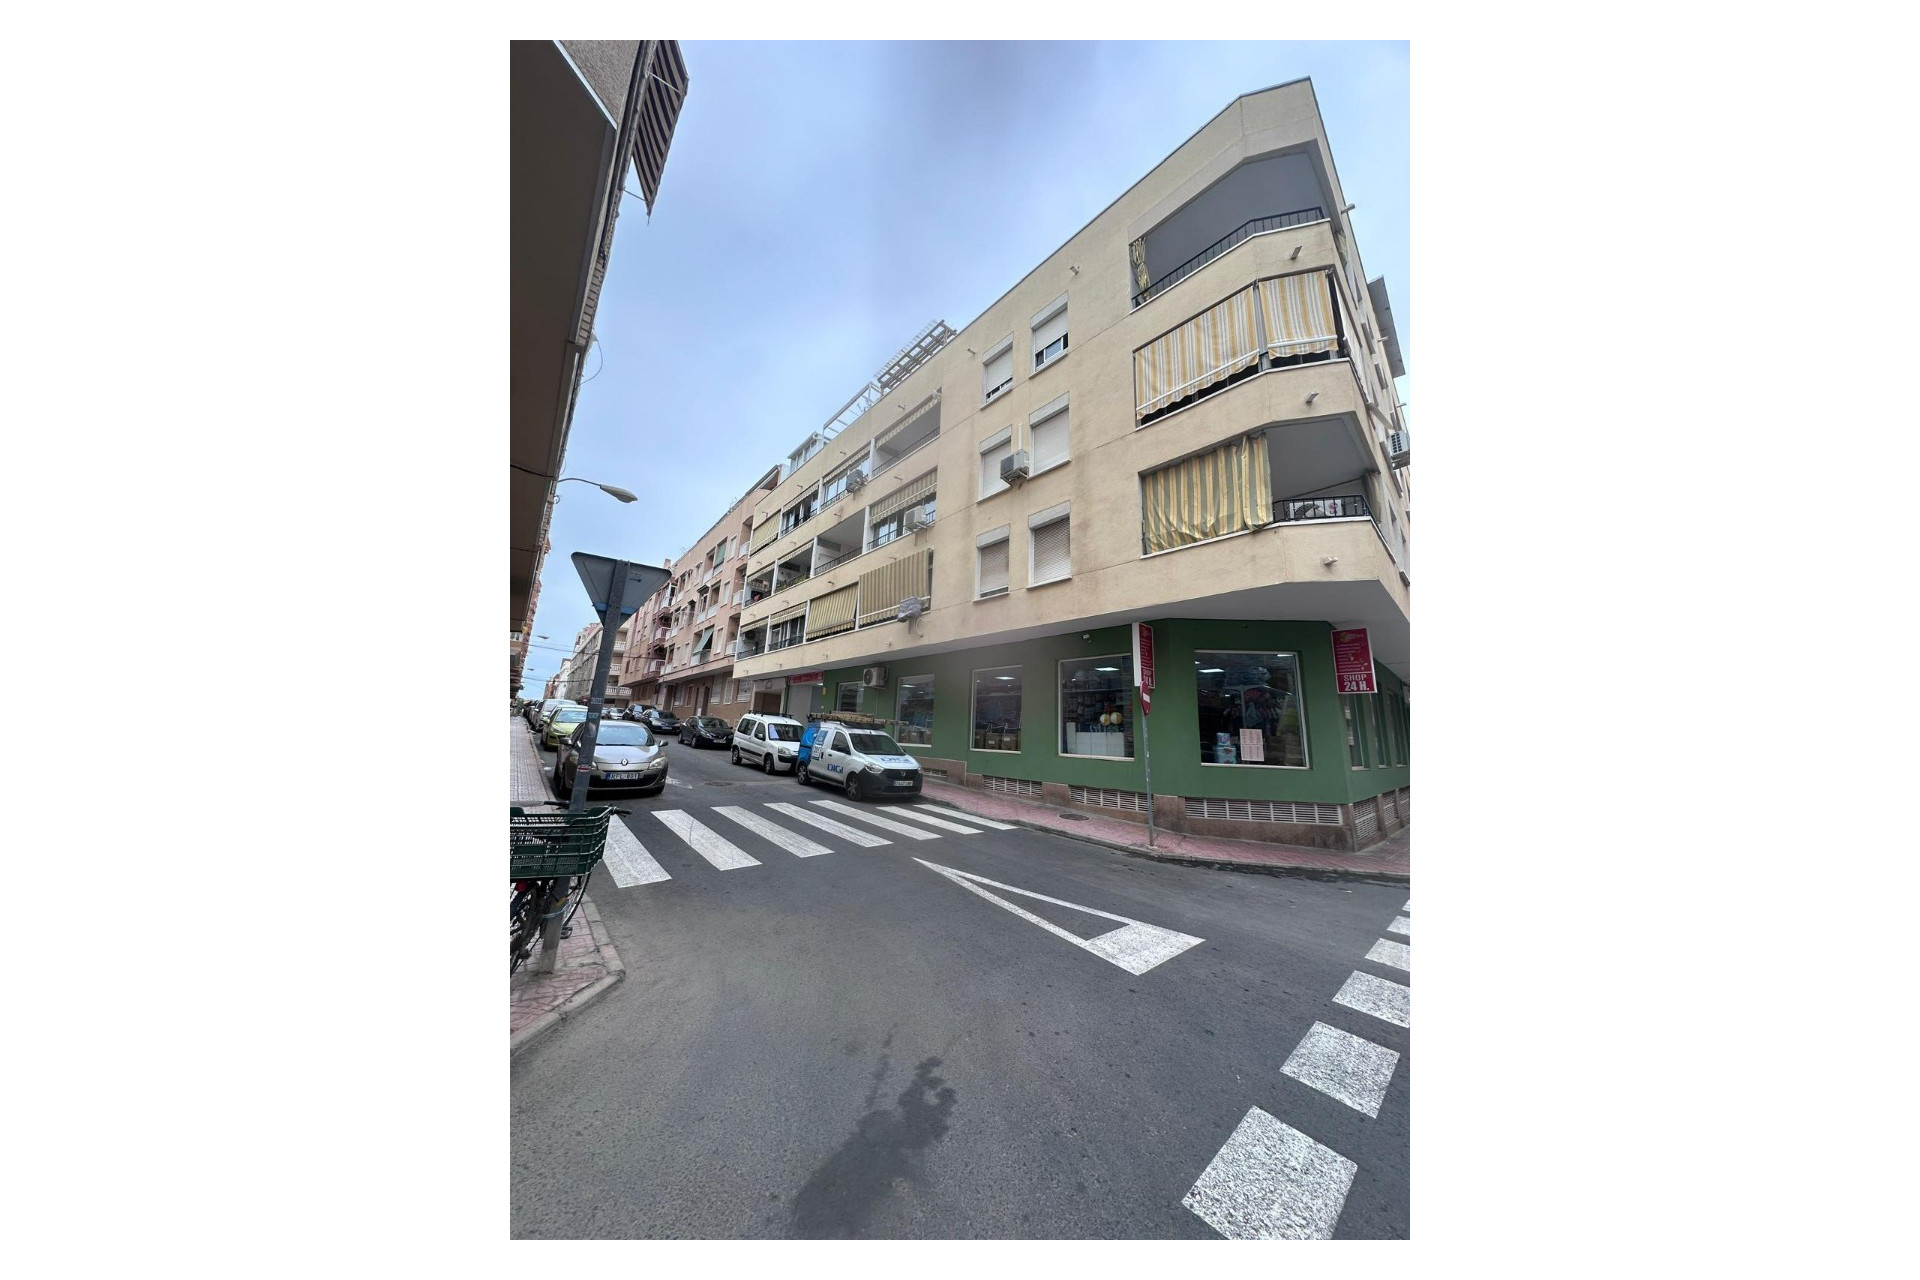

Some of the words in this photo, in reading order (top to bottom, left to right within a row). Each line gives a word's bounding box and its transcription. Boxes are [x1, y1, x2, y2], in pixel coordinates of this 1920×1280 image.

[1344, 682, 1358, 691] 24
[1359, 681, 1370, 691] H.
[827, 763, 844, 774] DIGI
